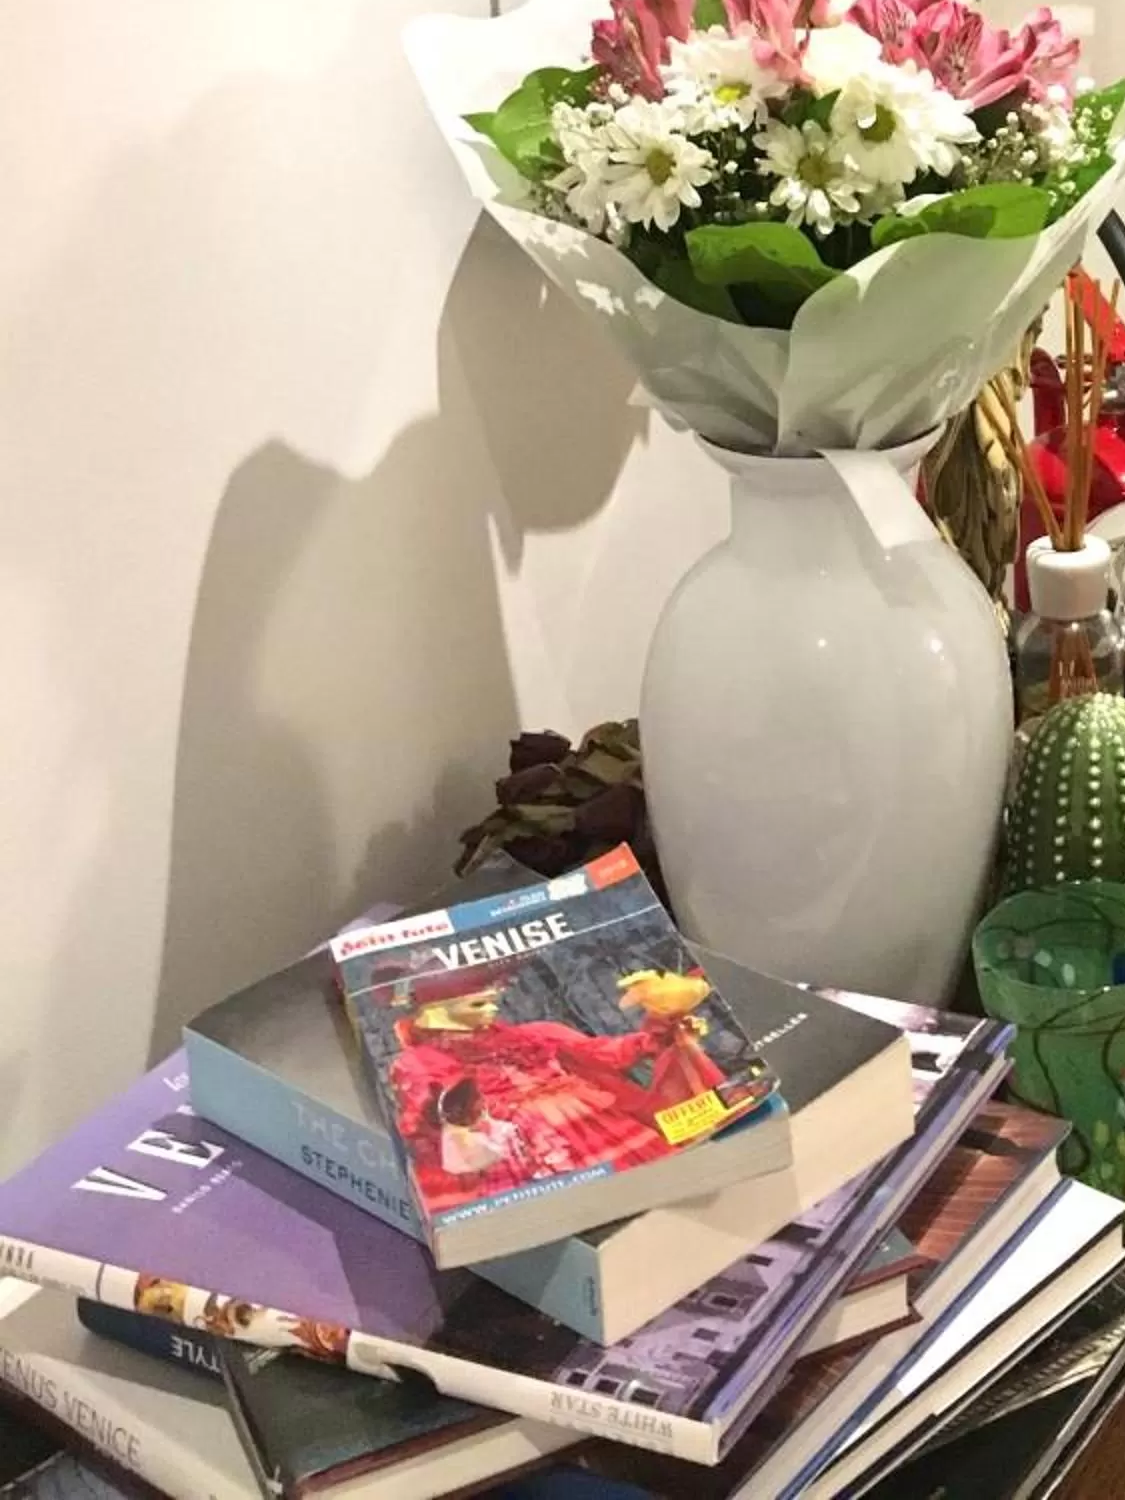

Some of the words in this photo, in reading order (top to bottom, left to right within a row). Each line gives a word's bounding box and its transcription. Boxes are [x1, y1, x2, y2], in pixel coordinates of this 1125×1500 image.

[432, 911, 575, 971] VENISE
[291, 1099, 349, 1153] THE
[356, 1139, 399, 1181] CH
[300, 1143, 411, 1221] STEPHENIE
[170, 1335, 221, 1374] TYLE
[0, 1346, 58, 1410] ENUS
[63, 1389, 142, 1470] VENICE
[605, 1404, 674, 1440] WHITE
